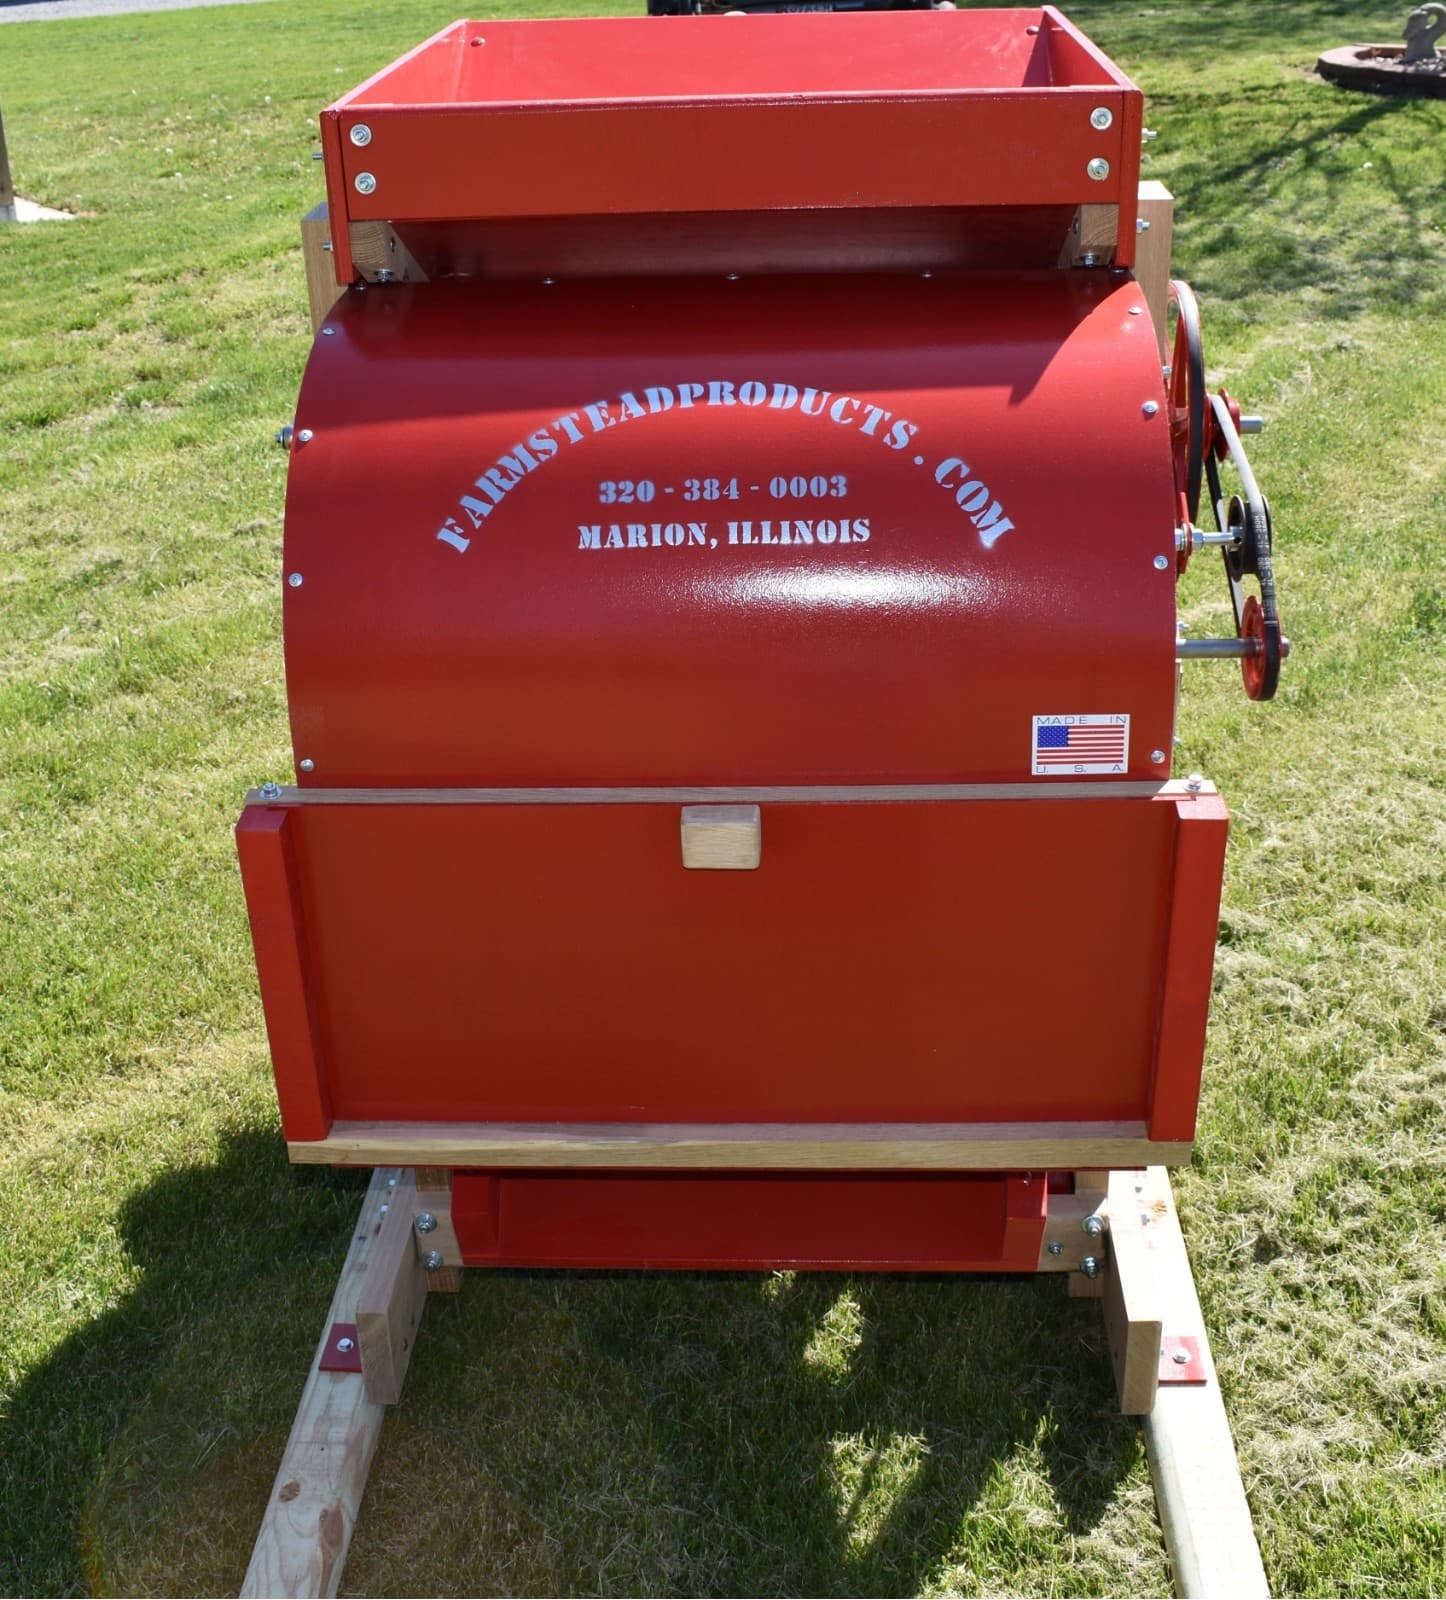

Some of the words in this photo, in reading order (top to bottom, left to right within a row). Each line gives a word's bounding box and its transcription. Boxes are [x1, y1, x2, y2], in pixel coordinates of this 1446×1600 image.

[599, 479, 656, 504] 320
[683, 477, 740, 501] 384
[769, 475, 848, 499] 0003
[577, 521, 718, 549] MARION,
[727, 518, 871, 546] ILLINOIS
[1036, 716, 1088, 725] MADE
[1109, 715, 1127, 724] IN
